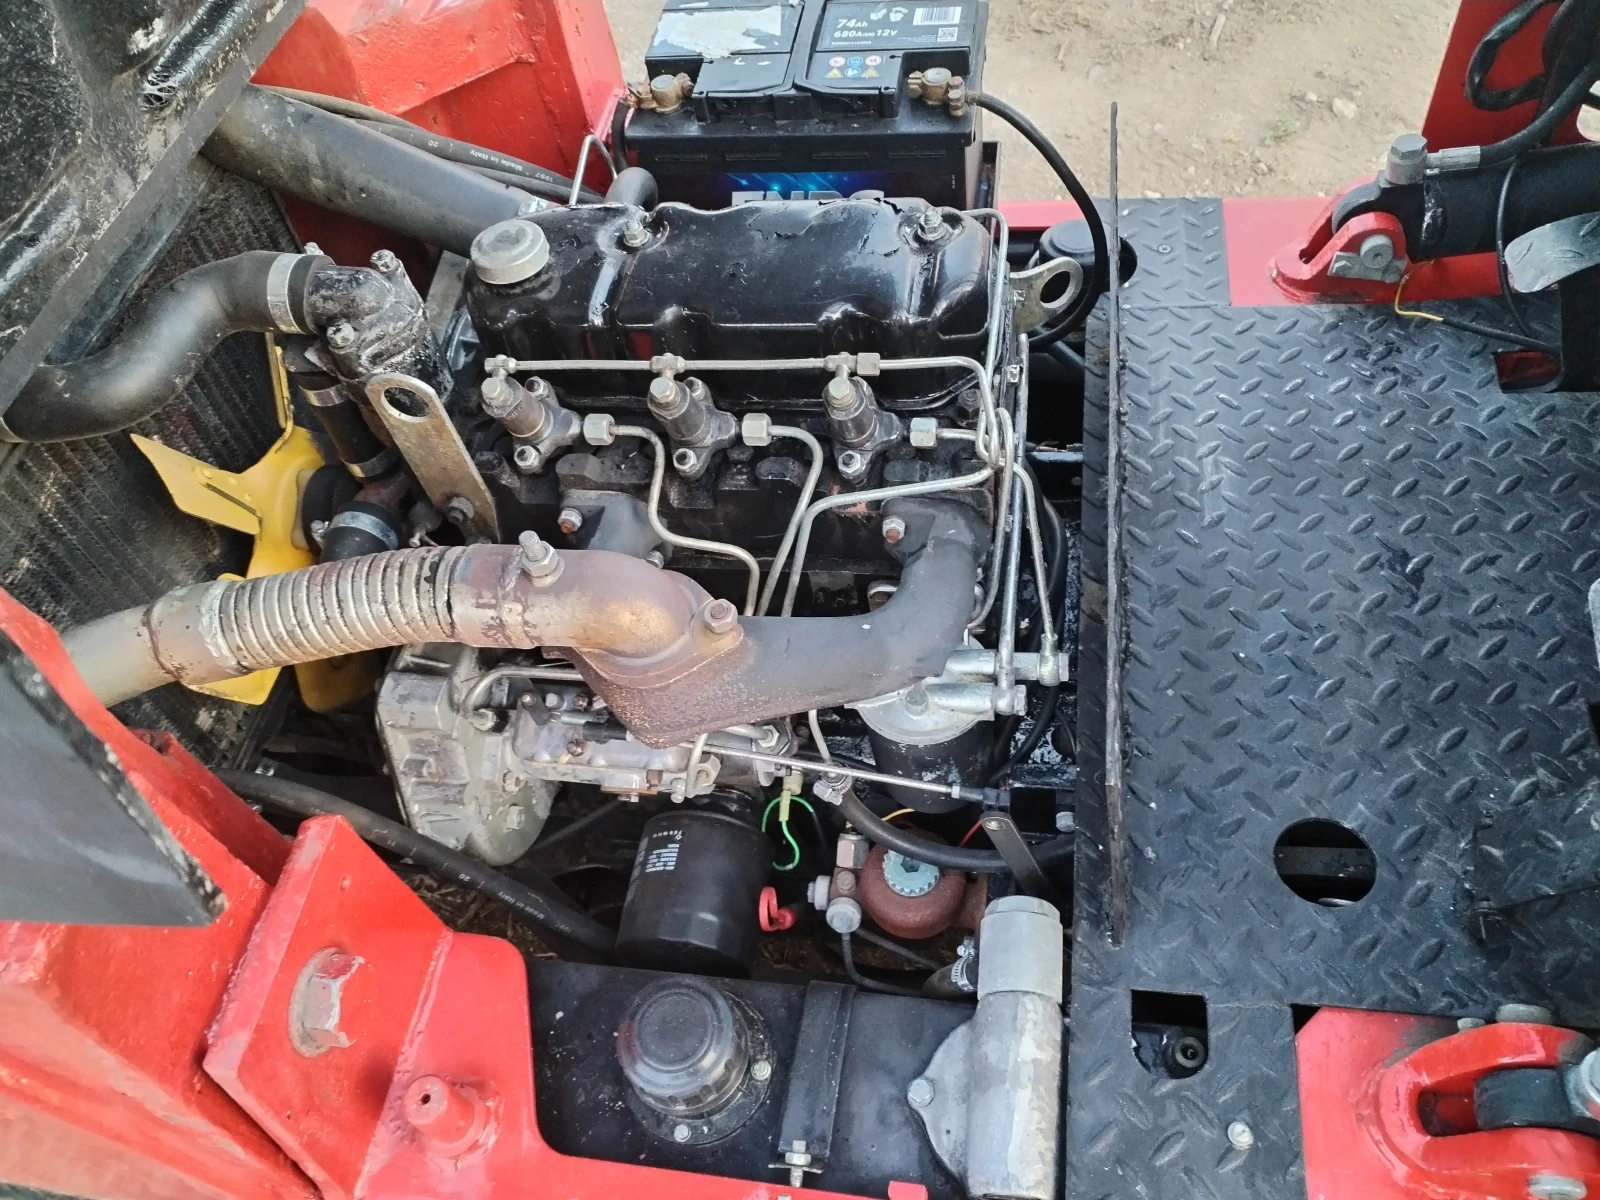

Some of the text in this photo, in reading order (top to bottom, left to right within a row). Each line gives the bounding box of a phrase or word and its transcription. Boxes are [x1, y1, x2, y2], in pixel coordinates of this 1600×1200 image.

[836, 19, 868, 28] 74Ah
[876, 29, 898, 37] 12V
[470, 149, 489, 160] Italy
[500, 159, 523, 171] Made
[459, 873, 471, 881] 20
[497, 891, 516, 904] Italy
[524, 906, 545, 919] Made
